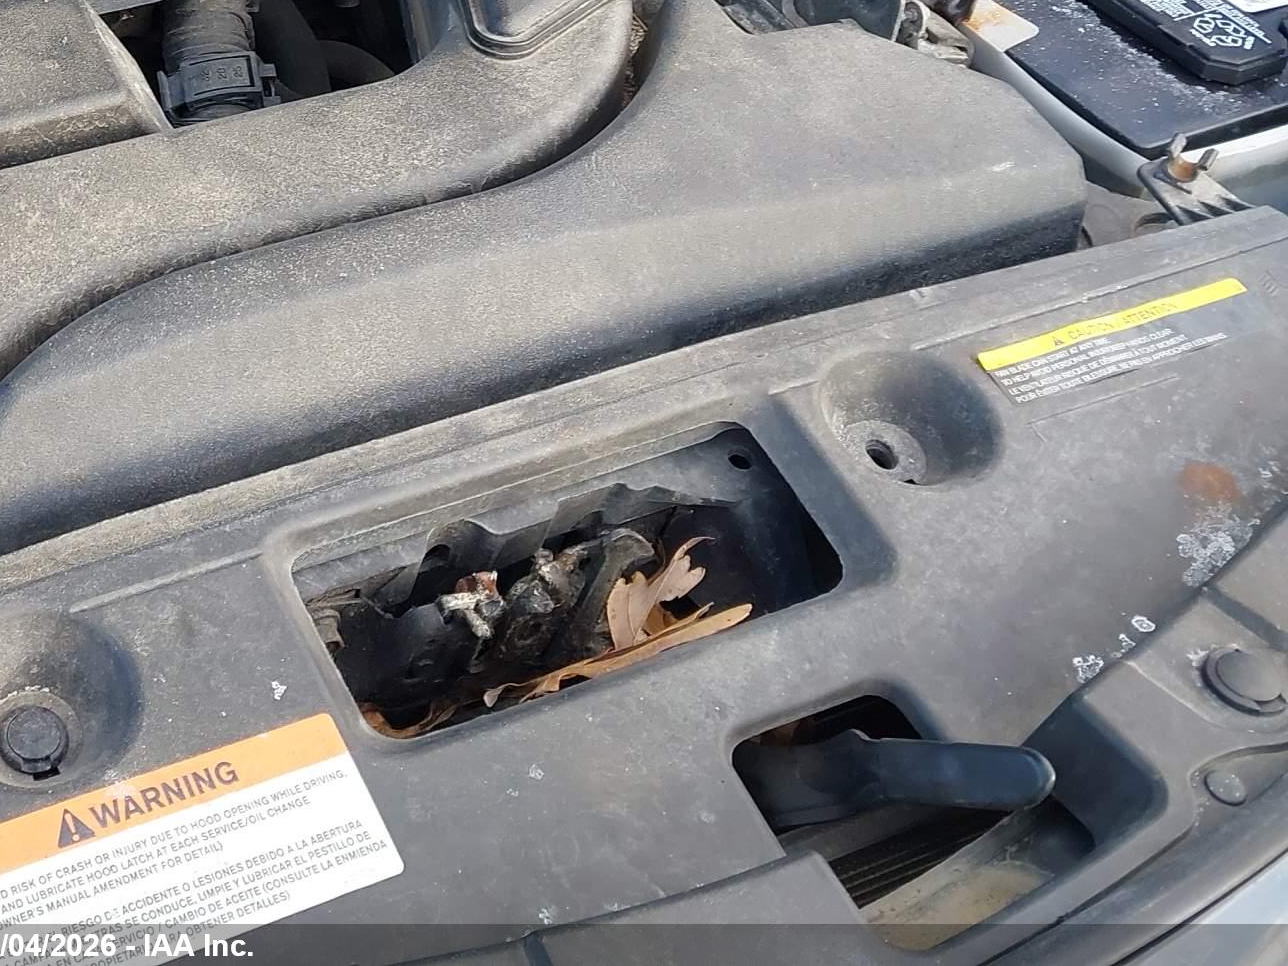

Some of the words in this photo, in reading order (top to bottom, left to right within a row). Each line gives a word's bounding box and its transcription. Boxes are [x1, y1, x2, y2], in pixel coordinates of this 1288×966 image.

[1068, 322, 1113, 339] CAUTION
[1122, 303, 1178, 324] ATTENTION
[10, 879, 35, 895] RISK
[38, 873, 53, 885] OF
[55, 859, 92, 879] CRASH
[94, 853, 110, 864] OR
[111, 839, 148, 858] INJURY
[150, 830, 173, 844] DUE
[175, 825, 188, 835] TO
[190, 813, 221, 830] HOOD
[223, 796, 269, 818] OPENING
[270, 784, 302, 801] WHILE
[303, 768, 347, 790] DRIVING,
[89, 761, 238, 828] WARNING
[0, 898, 23, 913] AND
[25, 876, 84, 904] LUBRICATE
[86, 864, 118, 882] HOOD
[120, 851, 154, 870] LATCH
[155, 846, 169, 857] AT
[170, 835, 199, 851] EACH
[200, 811, 265, 841] SERVICE/OIL
[266, 795, 310, 817] CHANGE
[46, 889, 90, 911] MANUAL
[91, 864, 159, 895] AMENDMENT
[160, 855, 182, 869] FOR
[184, 841, 223, 862] DETAIL)
[62, 915, 102, 936] RIESGO
[120, 886, 180, 914] ACCIDENTE
[181, 882, 191, 892] O
[192, 862, 244, 888] LESIONES
[245, 848, 284, 868] DEBIDO
[286, 844, 295, 853] A
[295, 839, 308, 849] LA
[309, 819, 362, 844] ABERTURA
[108, 926, 155, 950] ERVICIO
[164, 907, 206, 929] CAMBIO
[207, 900, 223, 912] DE
[224, 886, 261, 906] ACEITE
[261, 864, 319, 893] (CONSULTE
[320, 859, 333, 870] LA
[334, 839, 387, 864] ENMIENDA
[124, 916, 140, 928] SE
[140, 895, 196, 923] CONDUCE,
[197, 882, 232, 901] LIMPIE
[233, 878, 241, 887] Y
[242, 859, 292, 884] LUBRICAR
[293, 854, 307, 865] EL
[307, 836, 355, 860] PESTILLO
[355, 830, 371, 842] DE
[185, 911, 235, 936] OBTENER
[236, 890, 291, 918] DETALLES)
